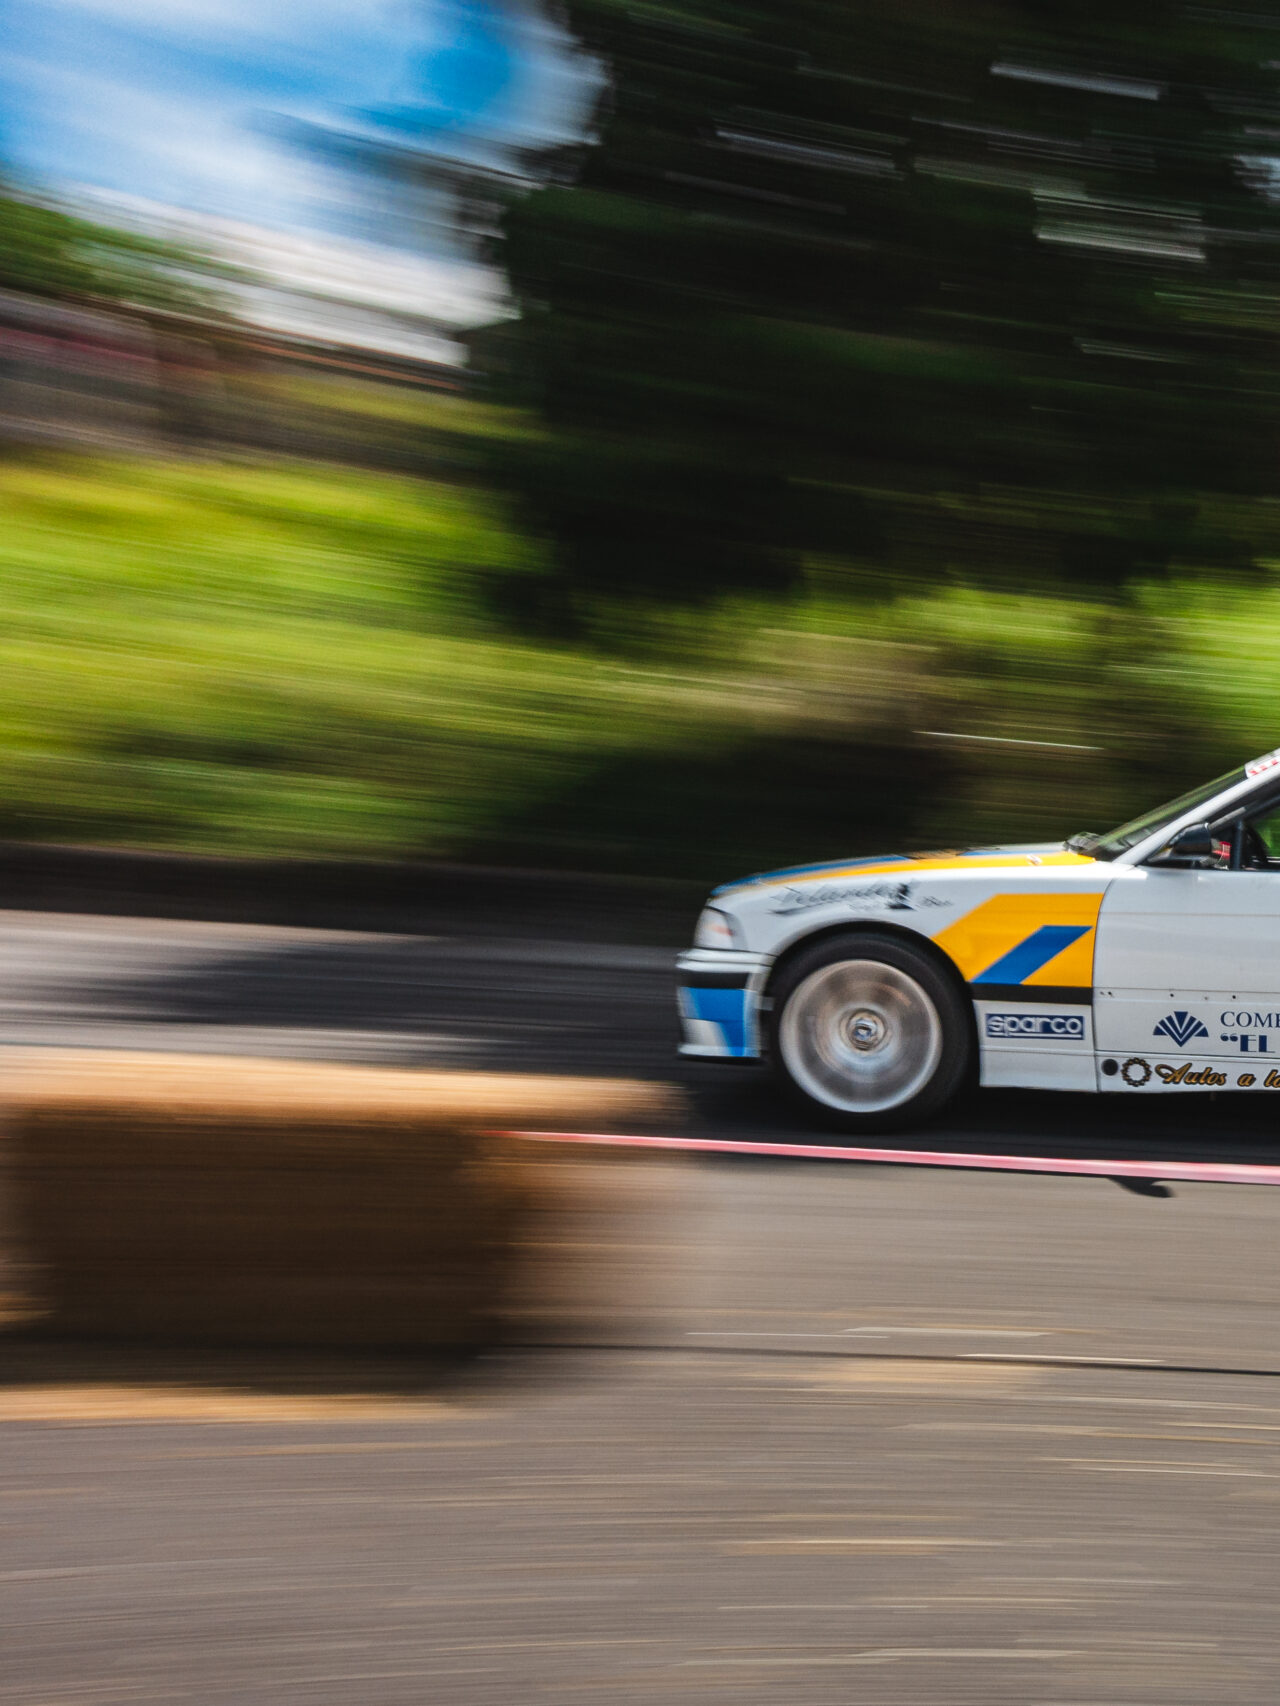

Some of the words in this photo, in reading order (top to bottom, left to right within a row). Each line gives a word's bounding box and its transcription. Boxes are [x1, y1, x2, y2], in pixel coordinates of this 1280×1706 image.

[987, 1016, 1082, 1037] sparco
[1155, 1062, 1227, 1086] Autos
[1237, 1073, 1257, 1087] a
